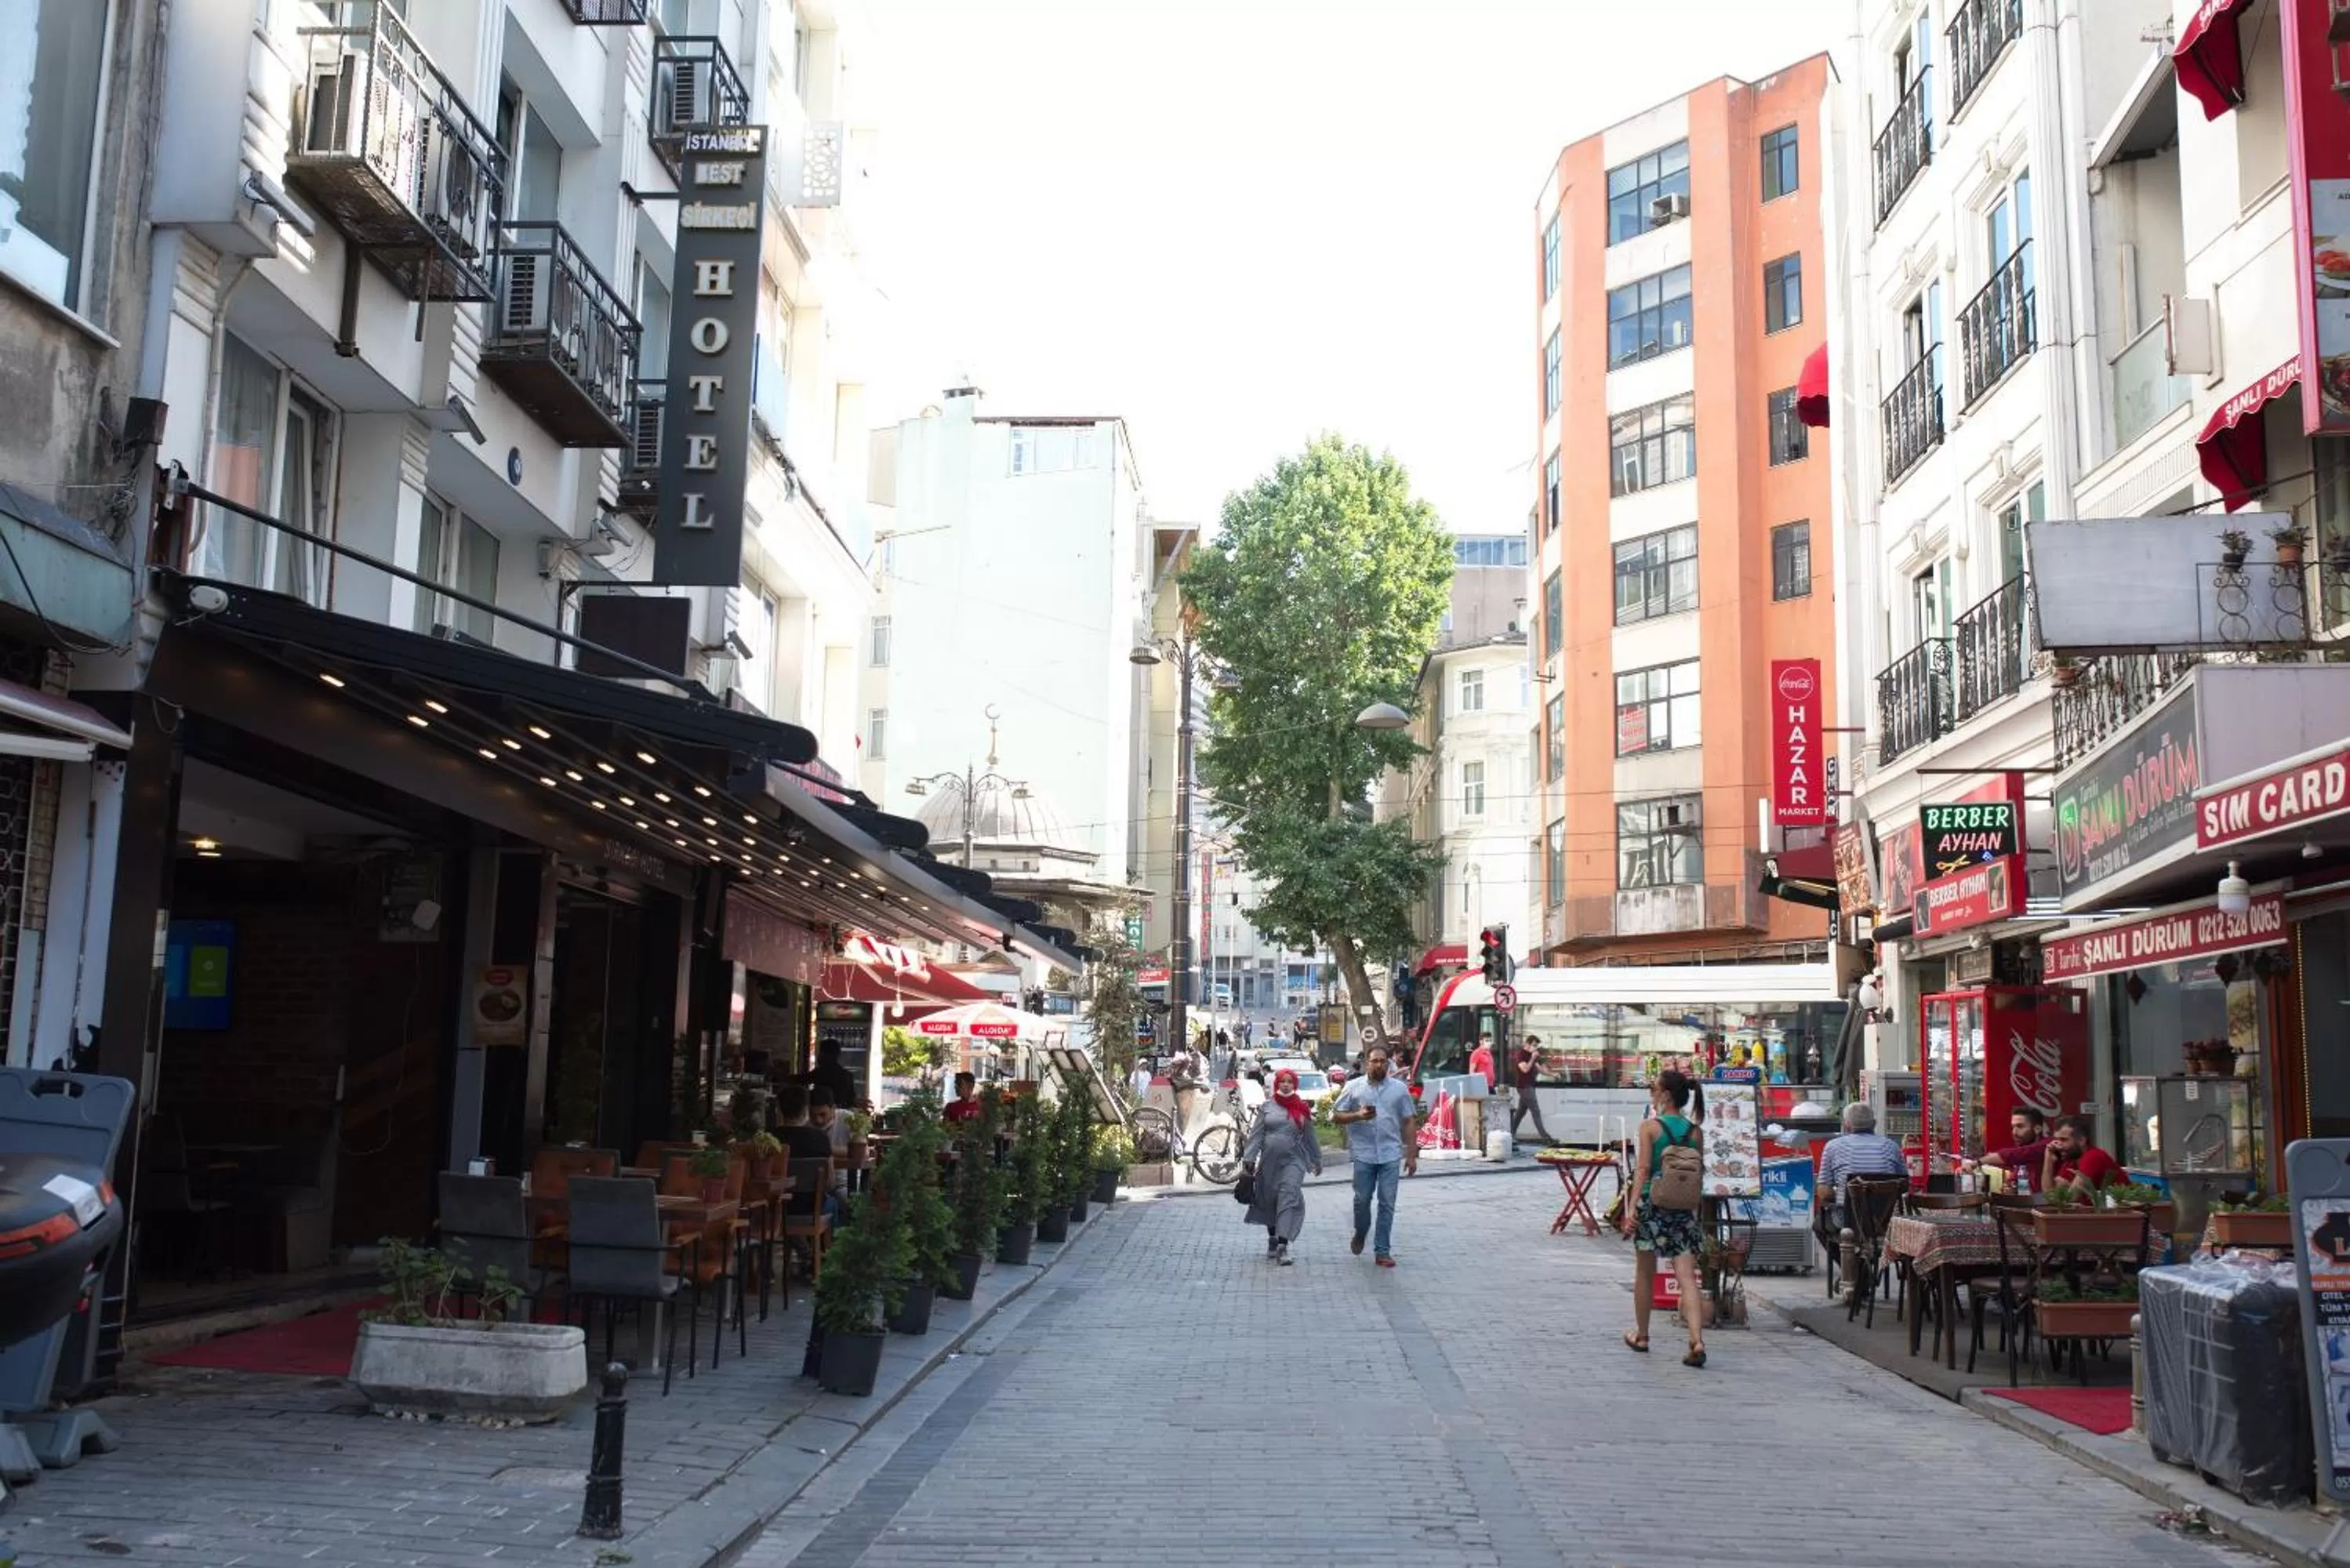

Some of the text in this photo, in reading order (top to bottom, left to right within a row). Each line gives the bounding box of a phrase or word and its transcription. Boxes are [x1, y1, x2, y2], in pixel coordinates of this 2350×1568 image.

[680, 260, 736, 529] HOTEL
[1788, 705, 1807, 805] HAZAR
[2123, 731, 2199, 826] DÜRÜM
[1778, 807, 1820, 816] MARKET
[1927, 806, 2009, 829] BERBER
[2204, 790, 2250, 838] SIM
[2258, 762, 2346, 822] CARD
[1938, 833, 2003, 852] AYHAN
[2083, 932, 2127, 971] ŞANLI
[2132, 917, 2192, 956] DÜRÜM
[2198, 916, 2225, 944] 0212
[2249, 899, 2281, 935] 0063
[978, 1026, 1009, 1035] ALGIDA
[2010, 1027, 2062, 1117] Cola
